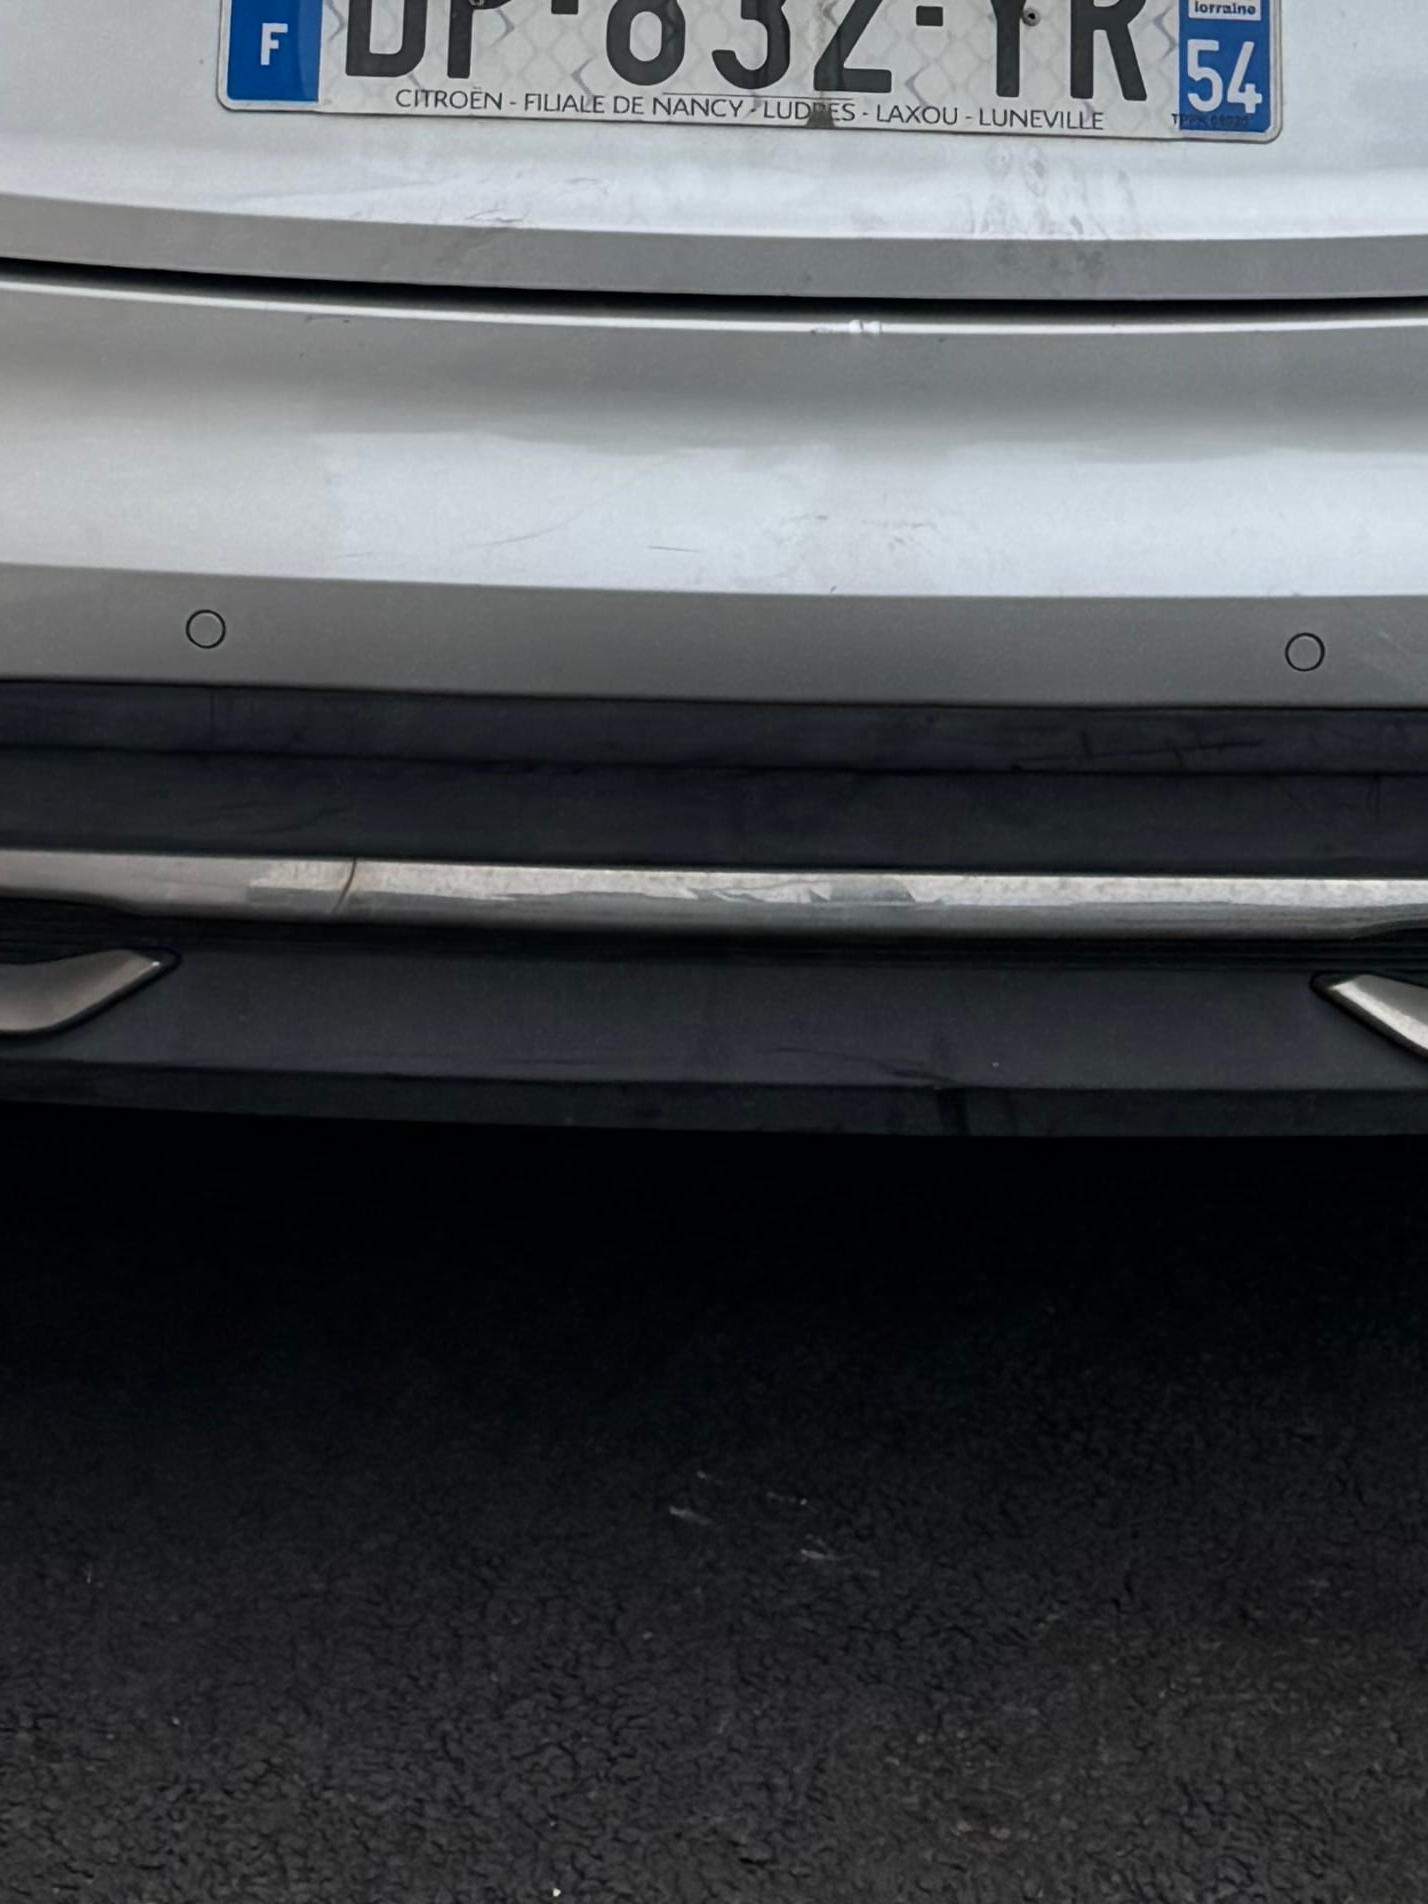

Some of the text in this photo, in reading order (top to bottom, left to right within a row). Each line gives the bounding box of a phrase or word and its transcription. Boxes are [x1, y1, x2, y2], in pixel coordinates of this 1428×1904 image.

[1193, 0, 1257, 16] lorraine
[260, 22, 289, 66] F
[1187, 38, 1264, 114] 54
[395, 85, 503, 111] CITROËN
[523, 92, 606, 114] FILIALE
[613, 95, 645, 115] DE
[652, 96, 744, 119] NANCY
[876, 104, 959, 125] LAXOU
[978, 107, 1105, 130] LUNEVILLE
